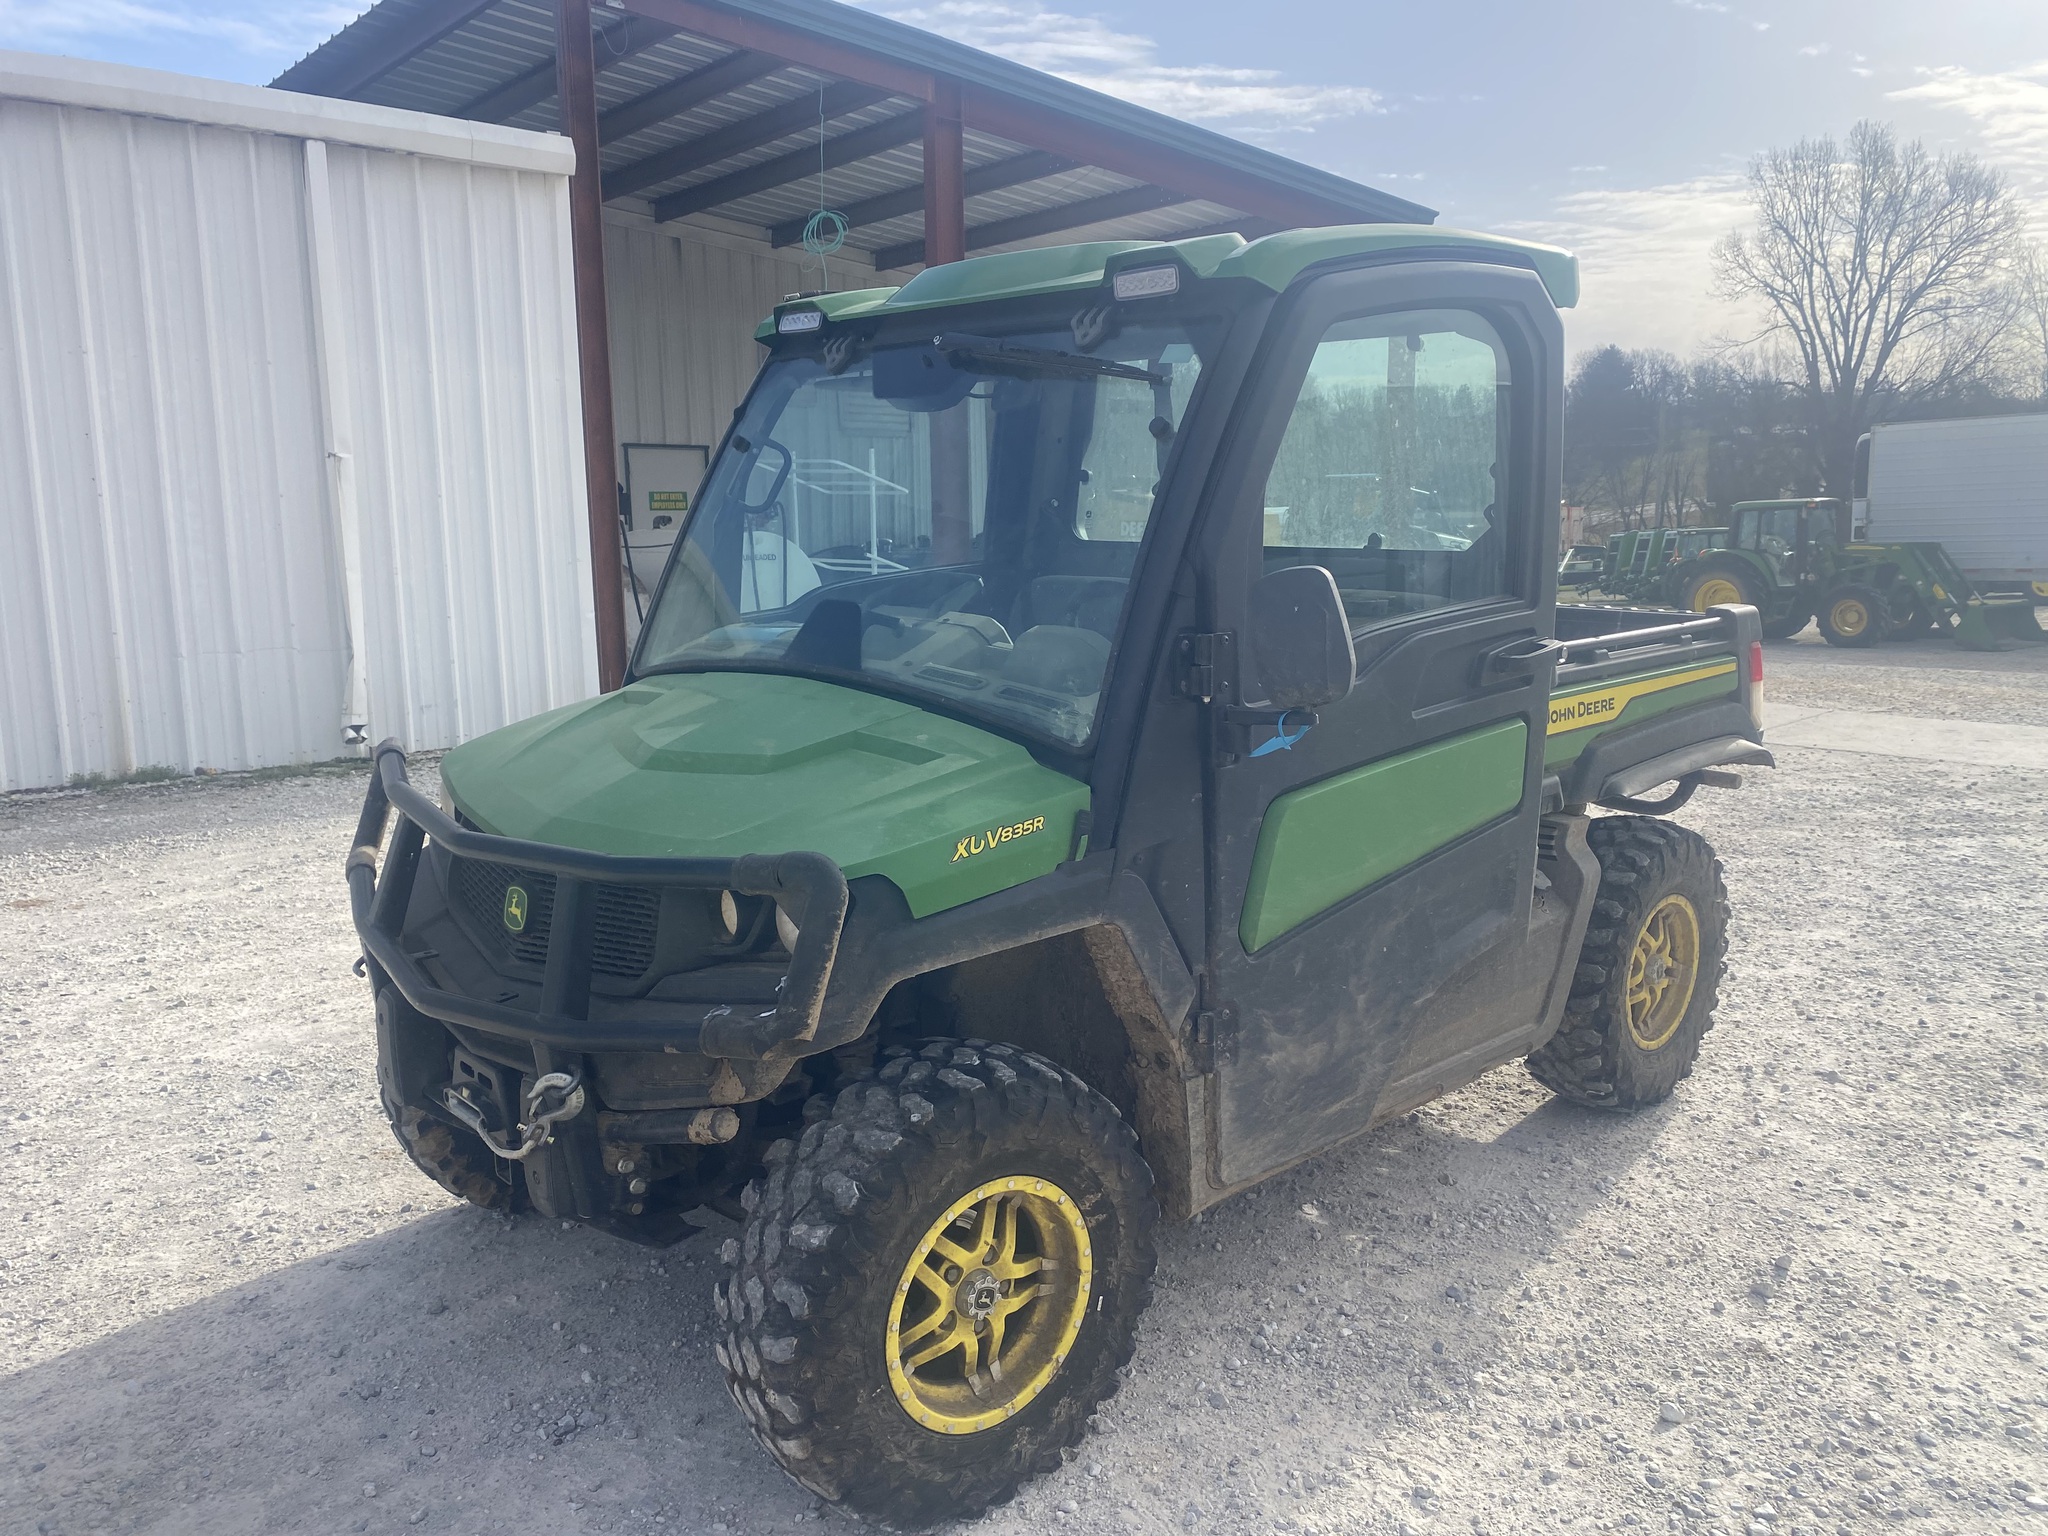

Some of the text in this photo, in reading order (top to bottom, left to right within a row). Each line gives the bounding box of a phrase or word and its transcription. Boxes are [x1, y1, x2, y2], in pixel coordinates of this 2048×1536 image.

[670, 493, 683, 501] ENTER
[1578, 698, 1615, 718] DEERE
[950, 815, 1045, 864] XUV835R
